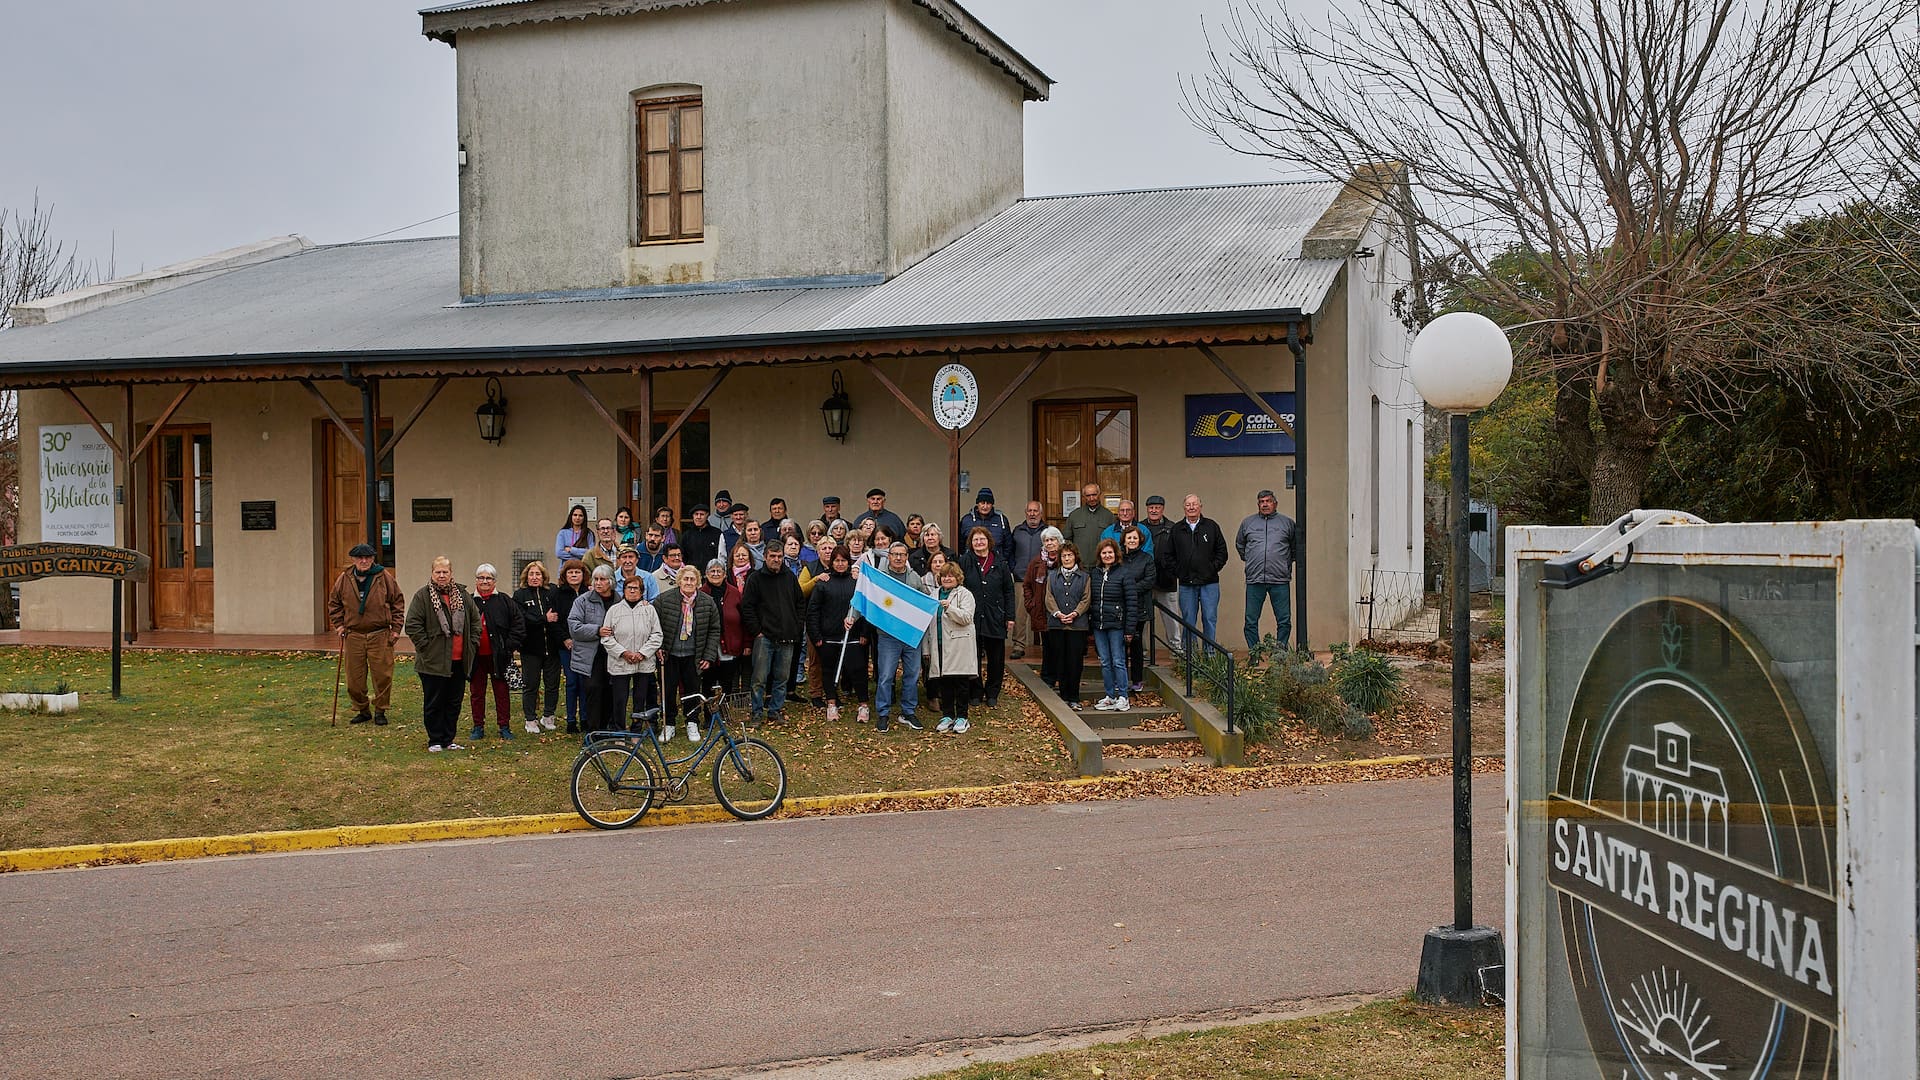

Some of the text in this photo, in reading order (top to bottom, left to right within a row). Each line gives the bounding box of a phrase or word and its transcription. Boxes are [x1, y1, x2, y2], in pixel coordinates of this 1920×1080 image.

[1246, 414, 1296, 424] COREO
[43, 456, 111, 482] Aniversario
[88, 476, 107, 489] de la
[44, 485, 110, 513] Biblioteca
[2, 548, 37, 558] Publica
[40, 546, 89, 556] Municipal
[101, 549, 137, 562] Popular
[32, 560, 53, 574] DE
[1555, 818, 1833, 996] SANTA REGINA
